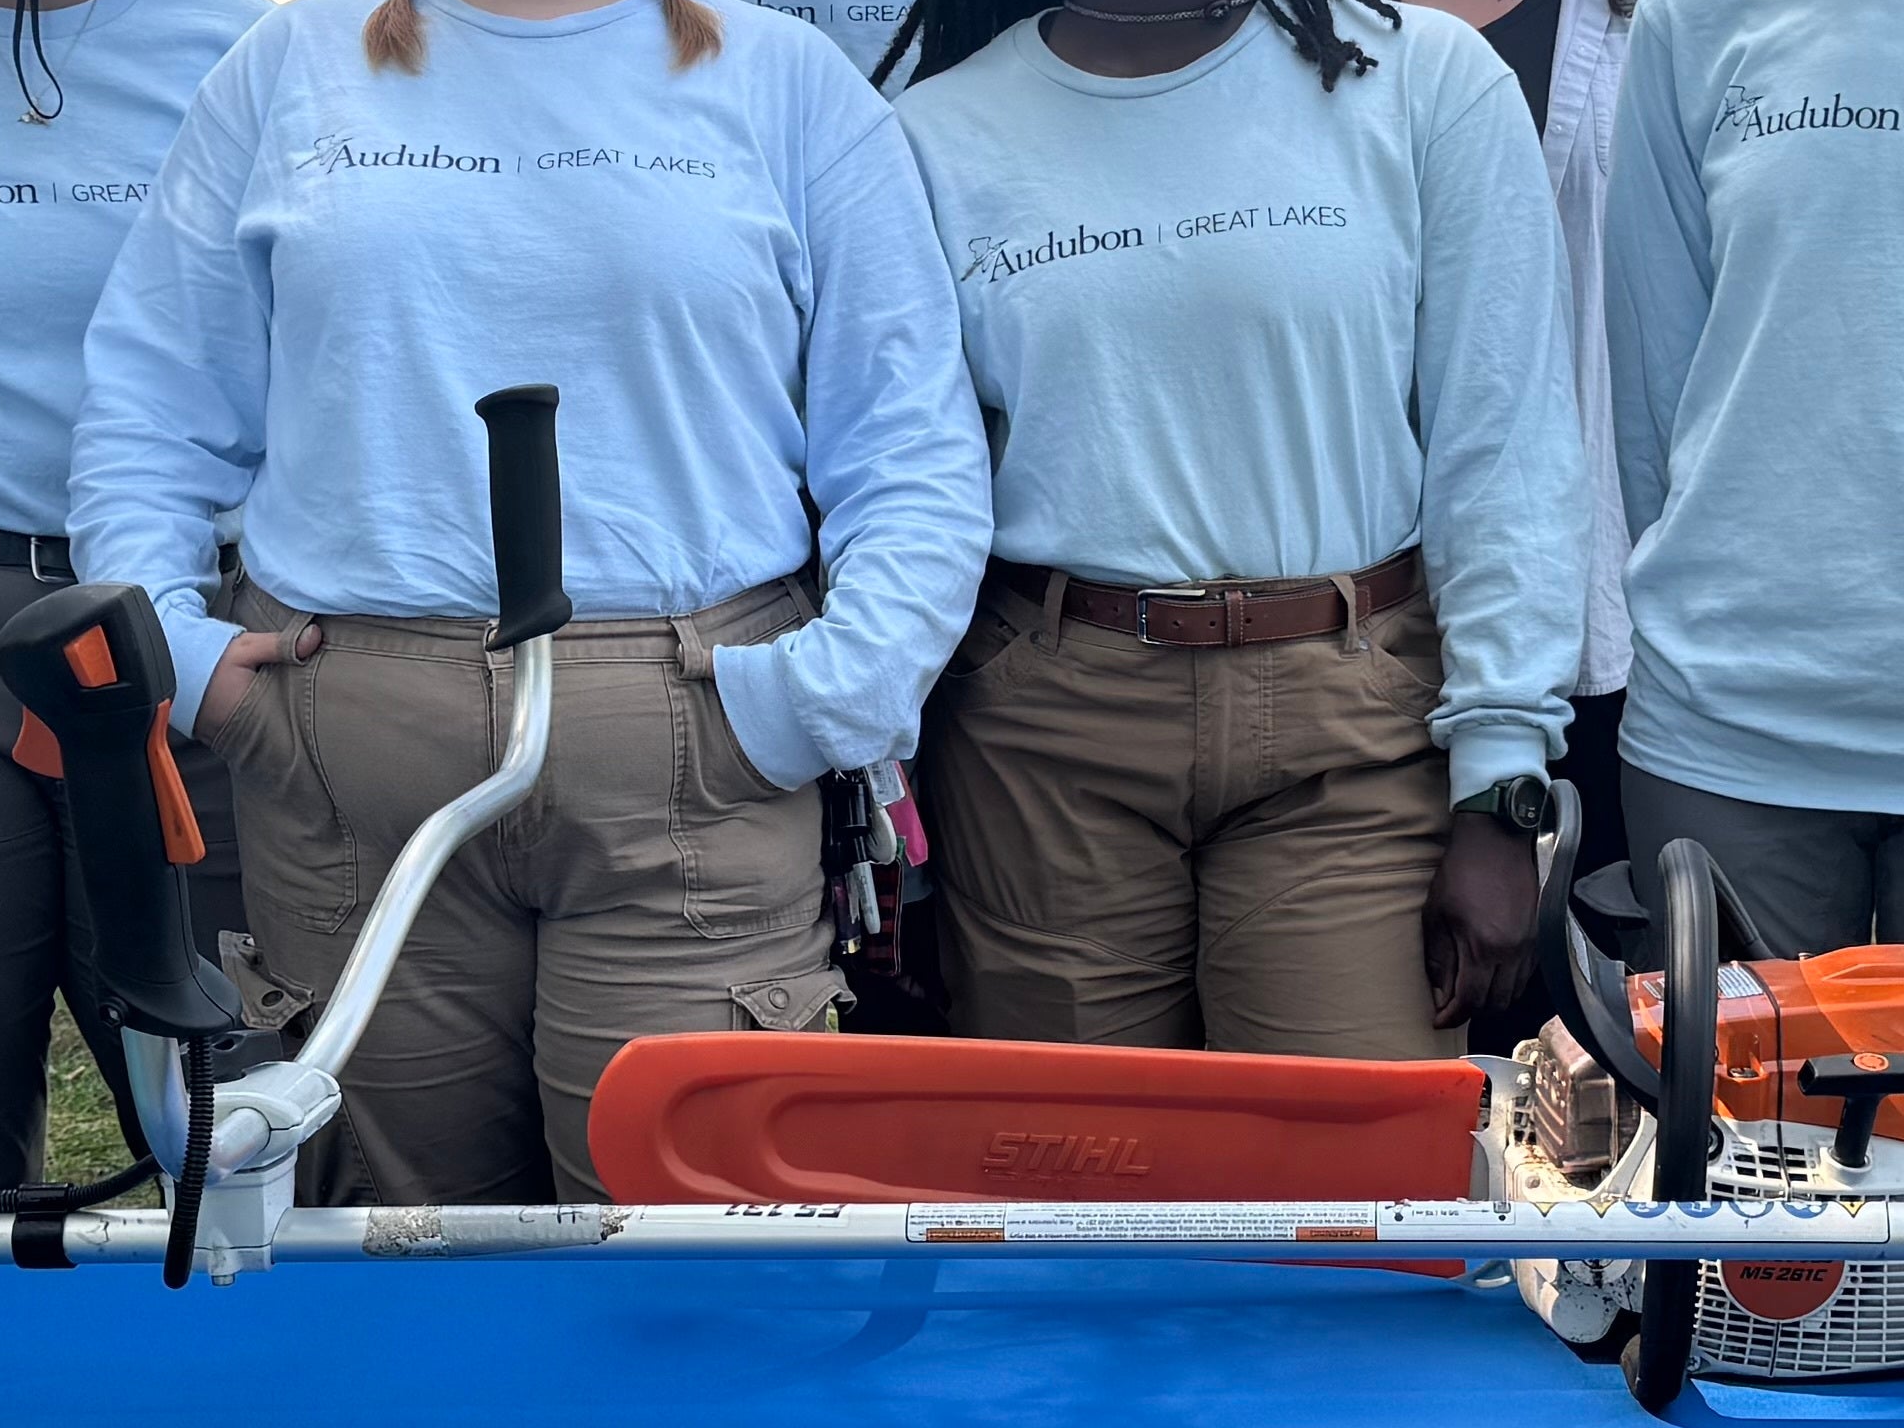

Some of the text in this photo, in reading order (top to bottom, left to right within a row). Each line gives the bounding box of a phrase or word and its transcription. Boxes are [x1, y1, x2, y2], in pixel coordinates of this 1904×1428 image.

[1741, 93, 1900, 142] Audubon
[328, 144, 717, 179] Audubon GREAT LAKES
[988, 206, 1347, 283] Audubon GREAT LAKES
[983, 1132, 1150, 1175] STIHL
[1739, 1266, 1778, 1281] MS
